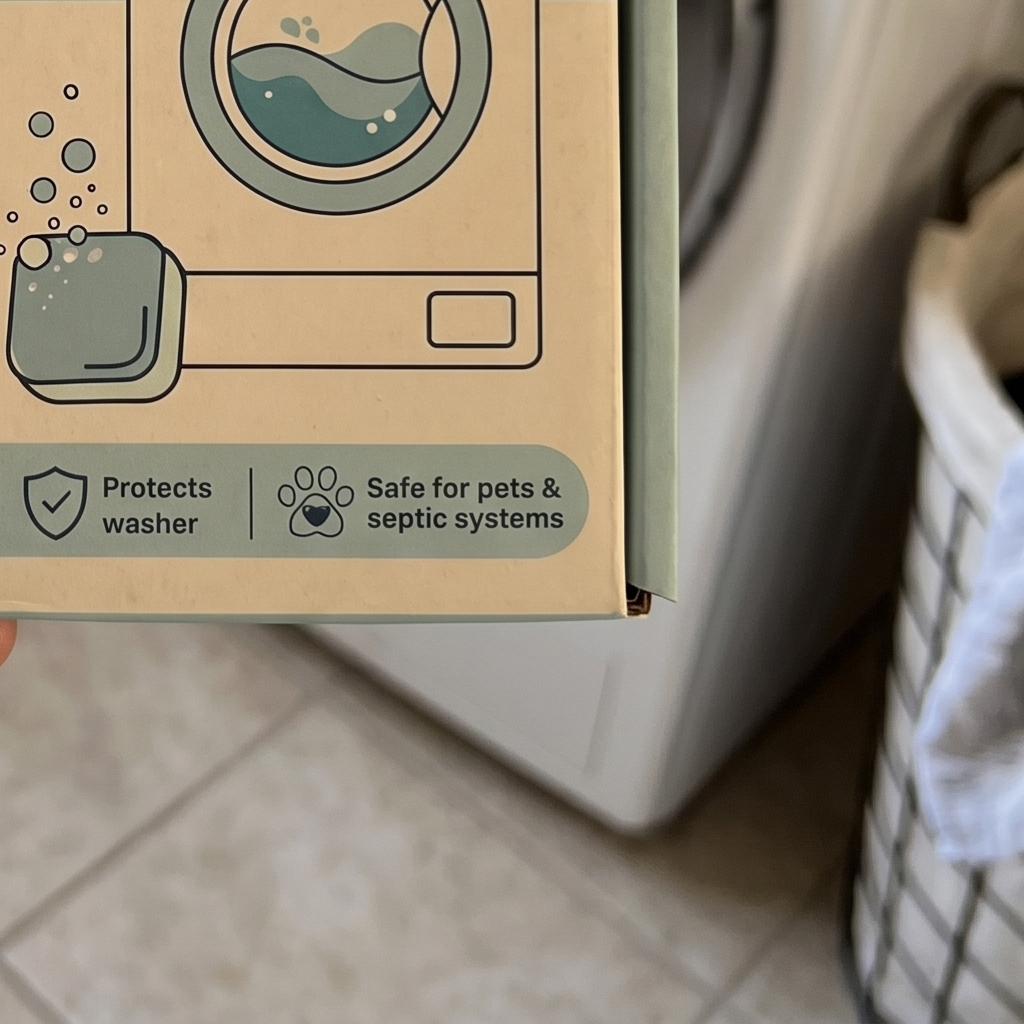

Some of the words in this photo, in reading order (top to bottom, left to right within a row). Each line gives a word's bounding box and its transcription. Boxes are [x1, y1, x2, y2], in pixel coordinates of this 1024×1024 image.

[103, 476, 212, 499] Protects
[367, 475, 425, 499] Safe
[431, 475, 470, 499] for
[478, 478, 535, 504] pets
[541, 477, 562, 499] &
[102, 512, 199, 535] washer
[367, 506, 448, 534] septic
[454, 508, 564, 535] systems
